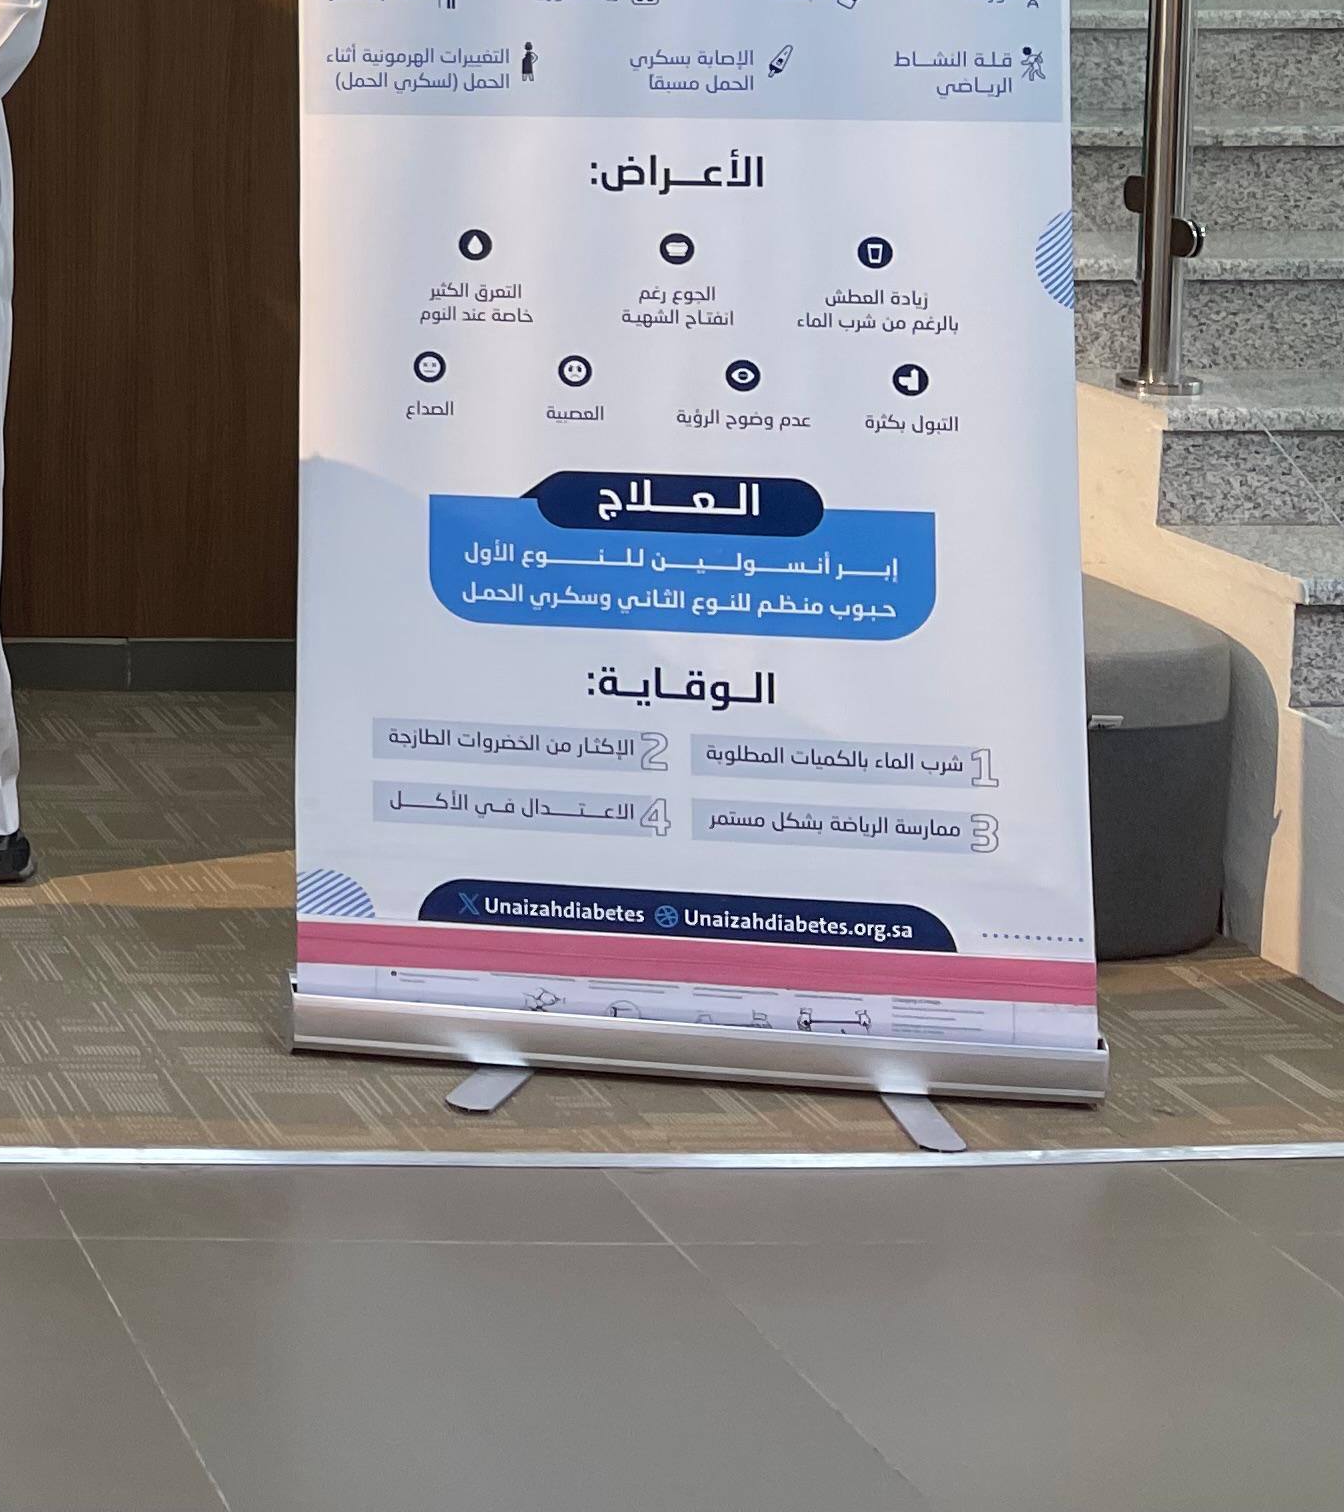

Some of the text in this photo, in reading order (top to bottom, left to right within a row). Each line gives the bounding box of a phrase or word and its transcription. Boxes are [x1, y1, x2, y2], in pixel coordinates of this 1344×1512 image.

[591, 149, 763, 195] الأعراض:
[406, 401, 453, 419] الصداع
[547, 406, 604, 423] العصبية
[599, 479, 759, 520] العلاج
[465, 540, 897, 582] إبر أنسولين للنوع الأول
[463, 582, 897, 622] حبوب منظم للنوع الثاني وسكري الحمل
[588, 667, 774, 711] الوقاية:
[389, 728, 668, 771] 2 الإكثار من الخضروات الطازجة
[707, 745, 999, 788] 1 شرب الماء بالكميات المطلوبة
[485, 897, 644, 922] Unaizahdiabetes
[685, 910, 913, 941] Unaizahdiabetes.org.sa
